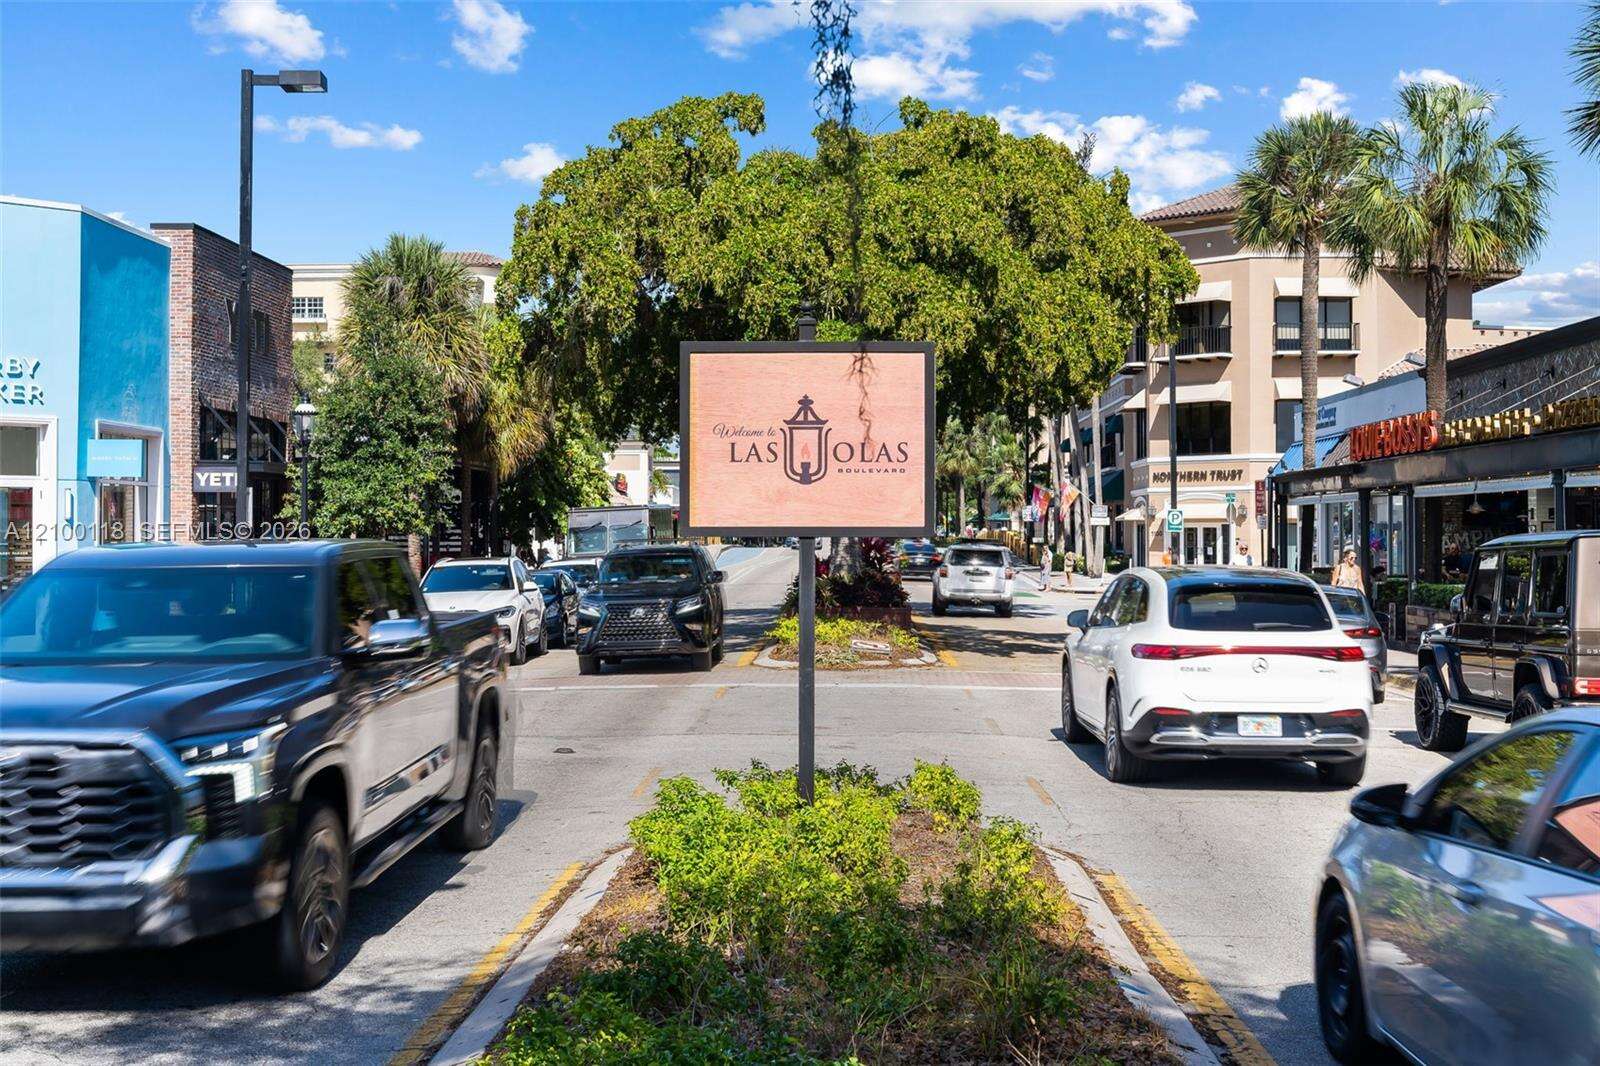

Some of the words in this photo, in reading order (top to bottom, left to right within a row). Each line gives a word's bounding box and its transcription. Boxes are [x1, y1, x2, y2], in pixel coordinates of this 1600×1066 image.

[712, 422, 764, 438] Welcome
[767, 426, 776, 437] to
[728, 441, 778, 463] LAS
[832, 441, 909, 463] OLAS
[1210, 469, 1244, 482] TRUST
[1171, 513, 1180, 523] P
